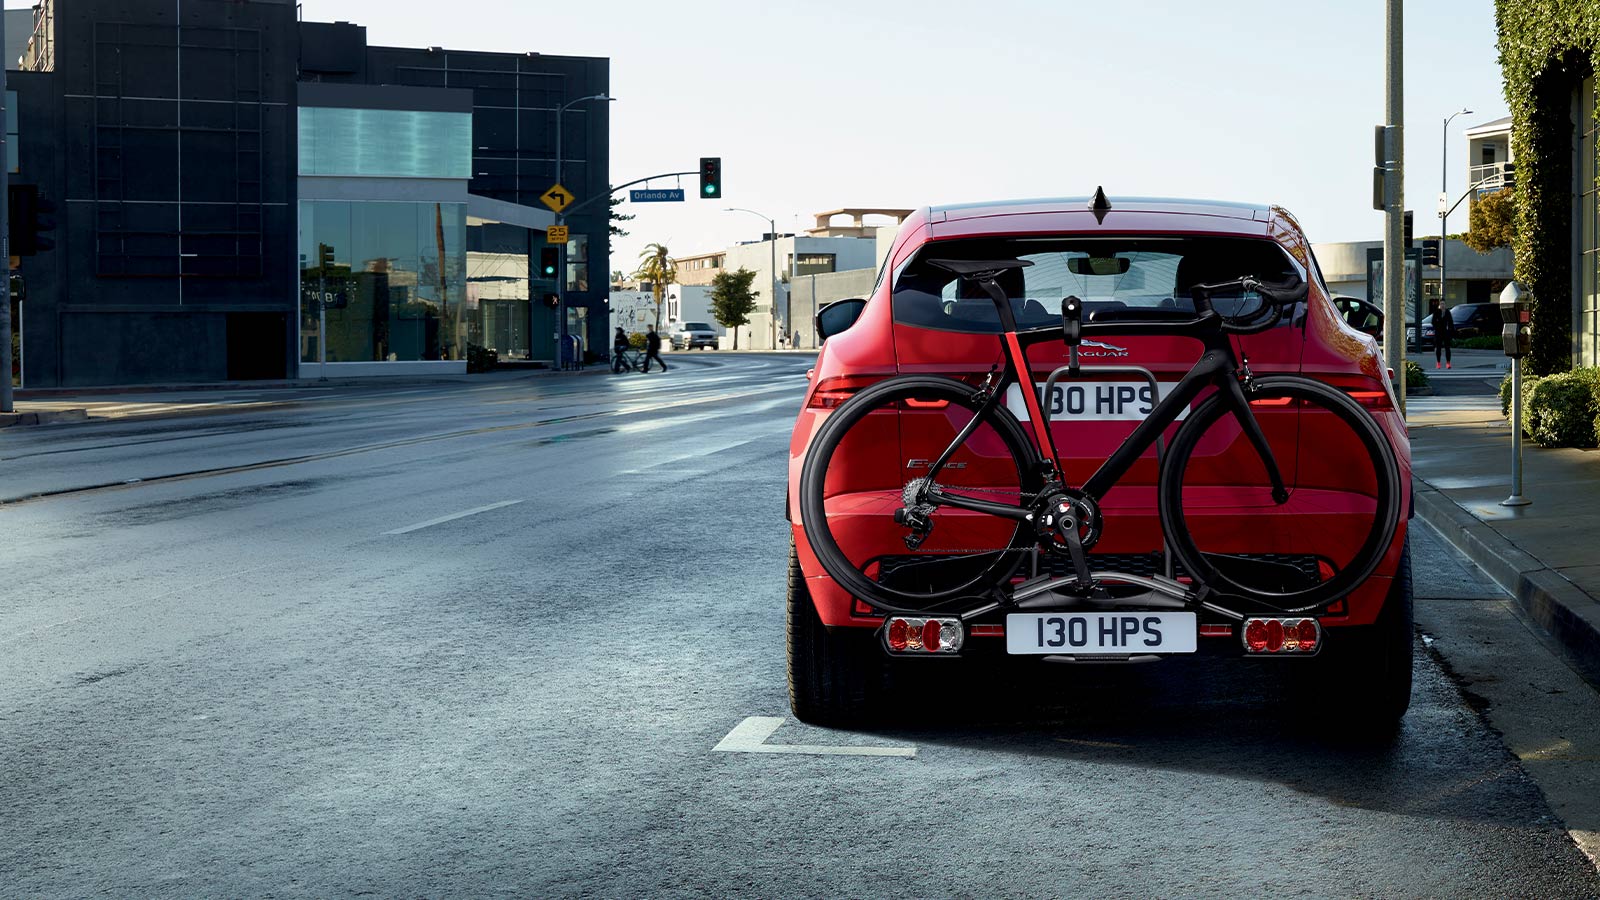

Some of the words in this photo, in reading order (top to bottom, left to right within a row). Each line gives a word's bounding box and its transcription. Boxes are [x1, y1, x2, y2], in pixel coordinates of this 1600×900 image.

[634, 191, 667, 199] Orlando
[669, 191, 680, 199] Av
[549, 227, 566, 236] 25
[1096, 386, 1153, 414] HPS
[1037, 617, 1088, 647] 130
[1098, 617, 1162, 647] HPS
